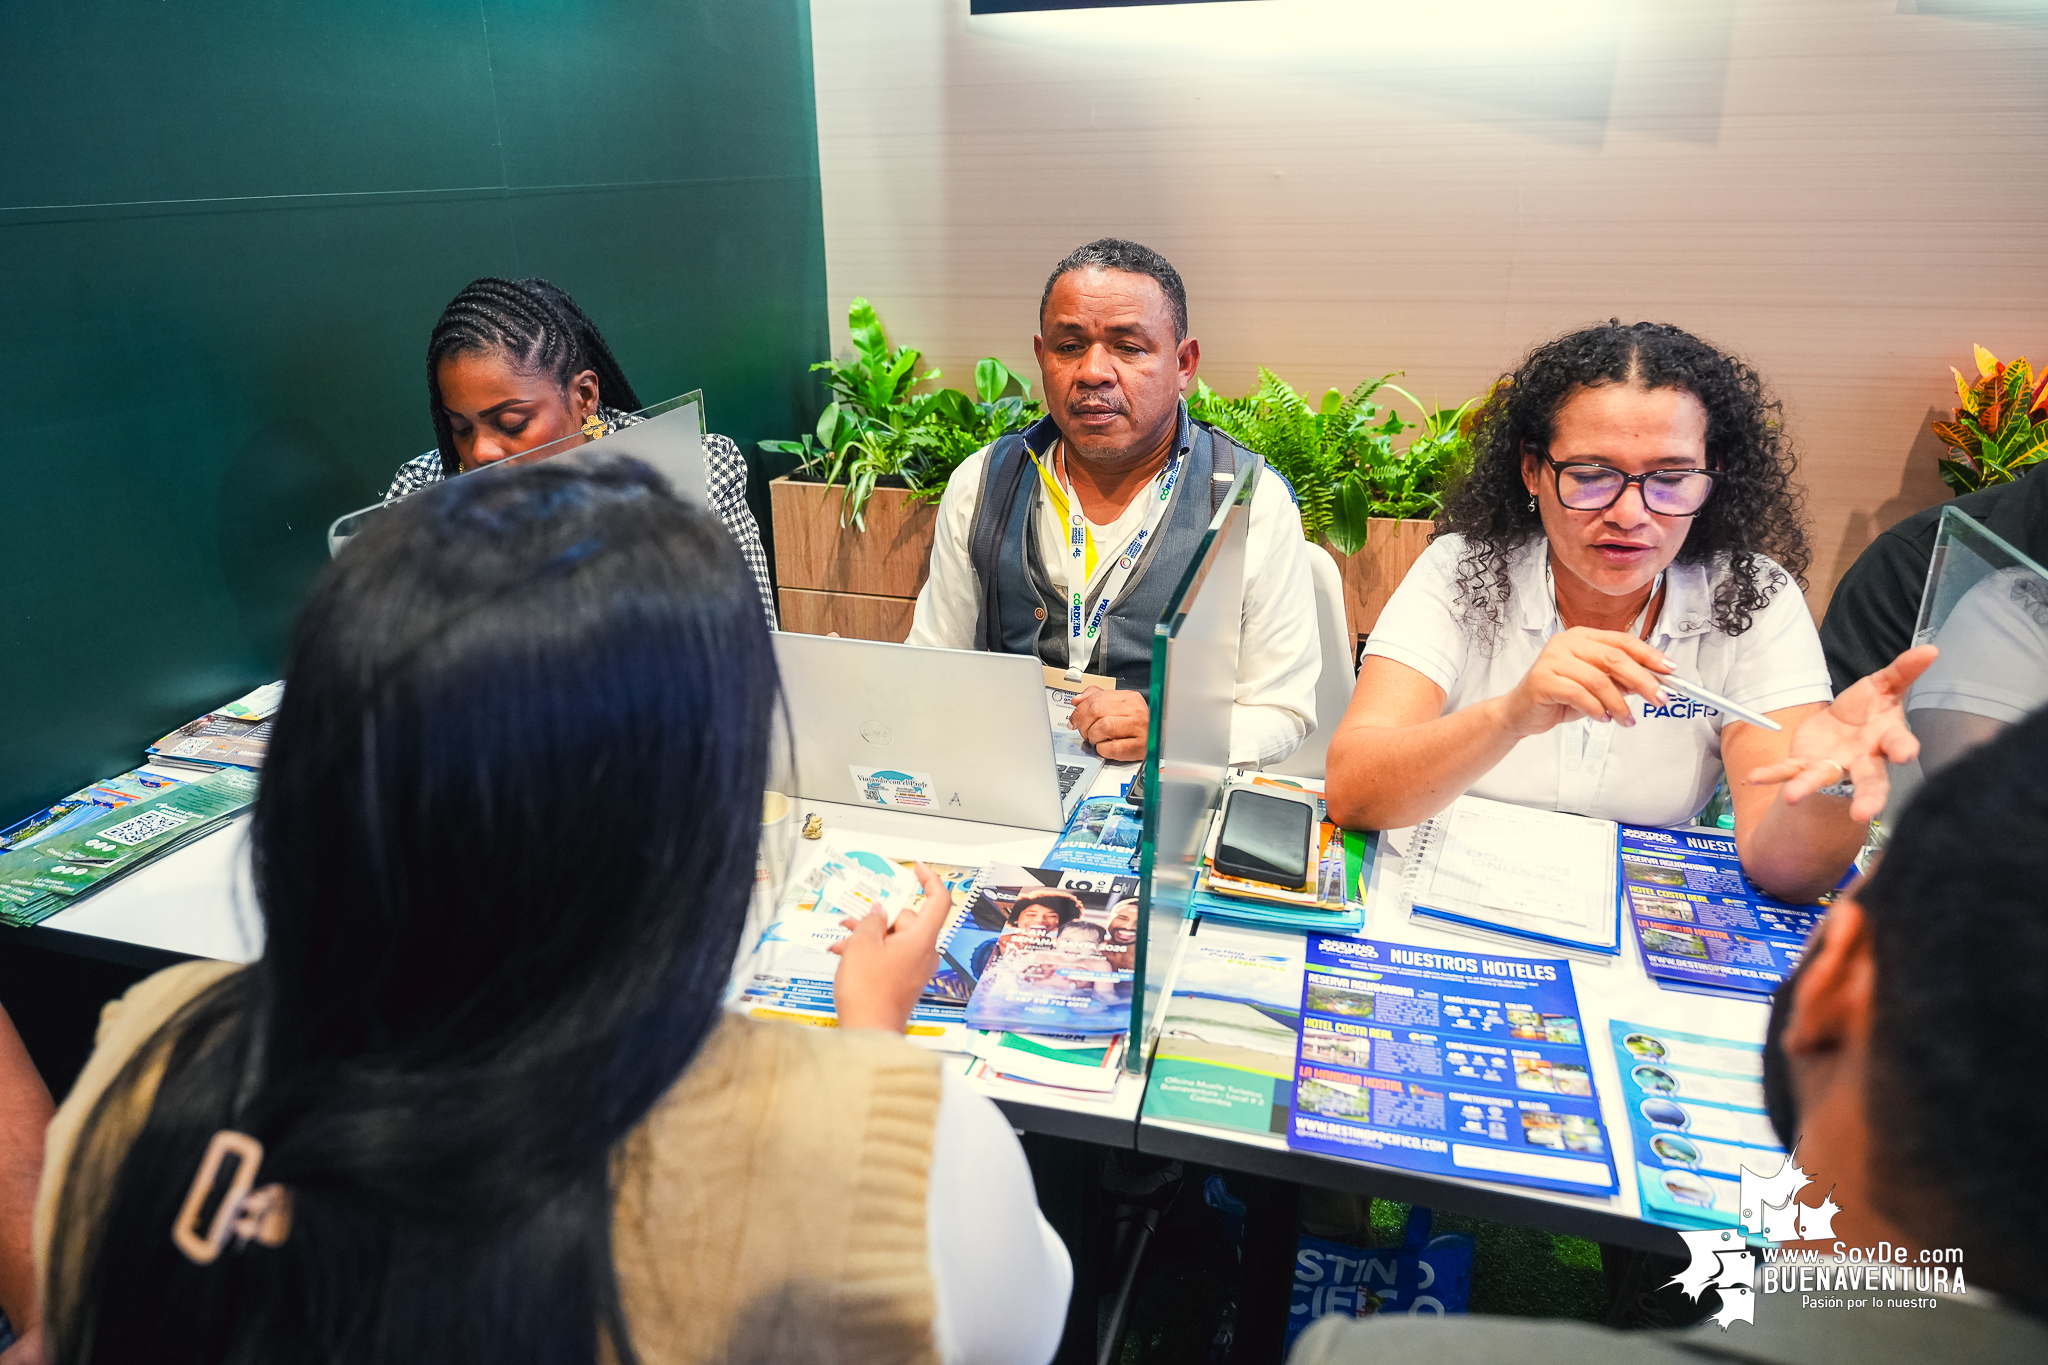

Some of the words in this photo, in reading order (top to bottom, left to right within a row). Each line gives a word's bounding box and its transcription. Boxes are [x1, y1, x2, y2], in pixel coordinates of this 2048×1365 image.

[1686, 837, 1737, 853] NUEST
[1629, 885, 1656, 896] HOTEL
[1656, 889, 1686, 901] COSTA
[1390, 948, 1479, 974] NUESTROS
[1482, 960, 1557, 981] HOTELES
[1308, 972, 1350, 988] RESERVA
[1350, 979, 1415, 998] AGUAMARINA
[1304, 1017, 1334, 1032] HOTEL
[1335, 1021, 1368, 1037] COSTA
[1369, 1027, 1394, 1042] REAL
[1164, 1076, 1196, 1087] Oficina
[1196, 1080, 1226, 1092] Muelle
[1299, 1065, 1313, 1078] LA
[1363, 1076, 1405, 1094] HOSTAL
[1160, 1082, 1219, 1098] Buenaventura
[1189, 1093, 1233, 1108] Colombia
